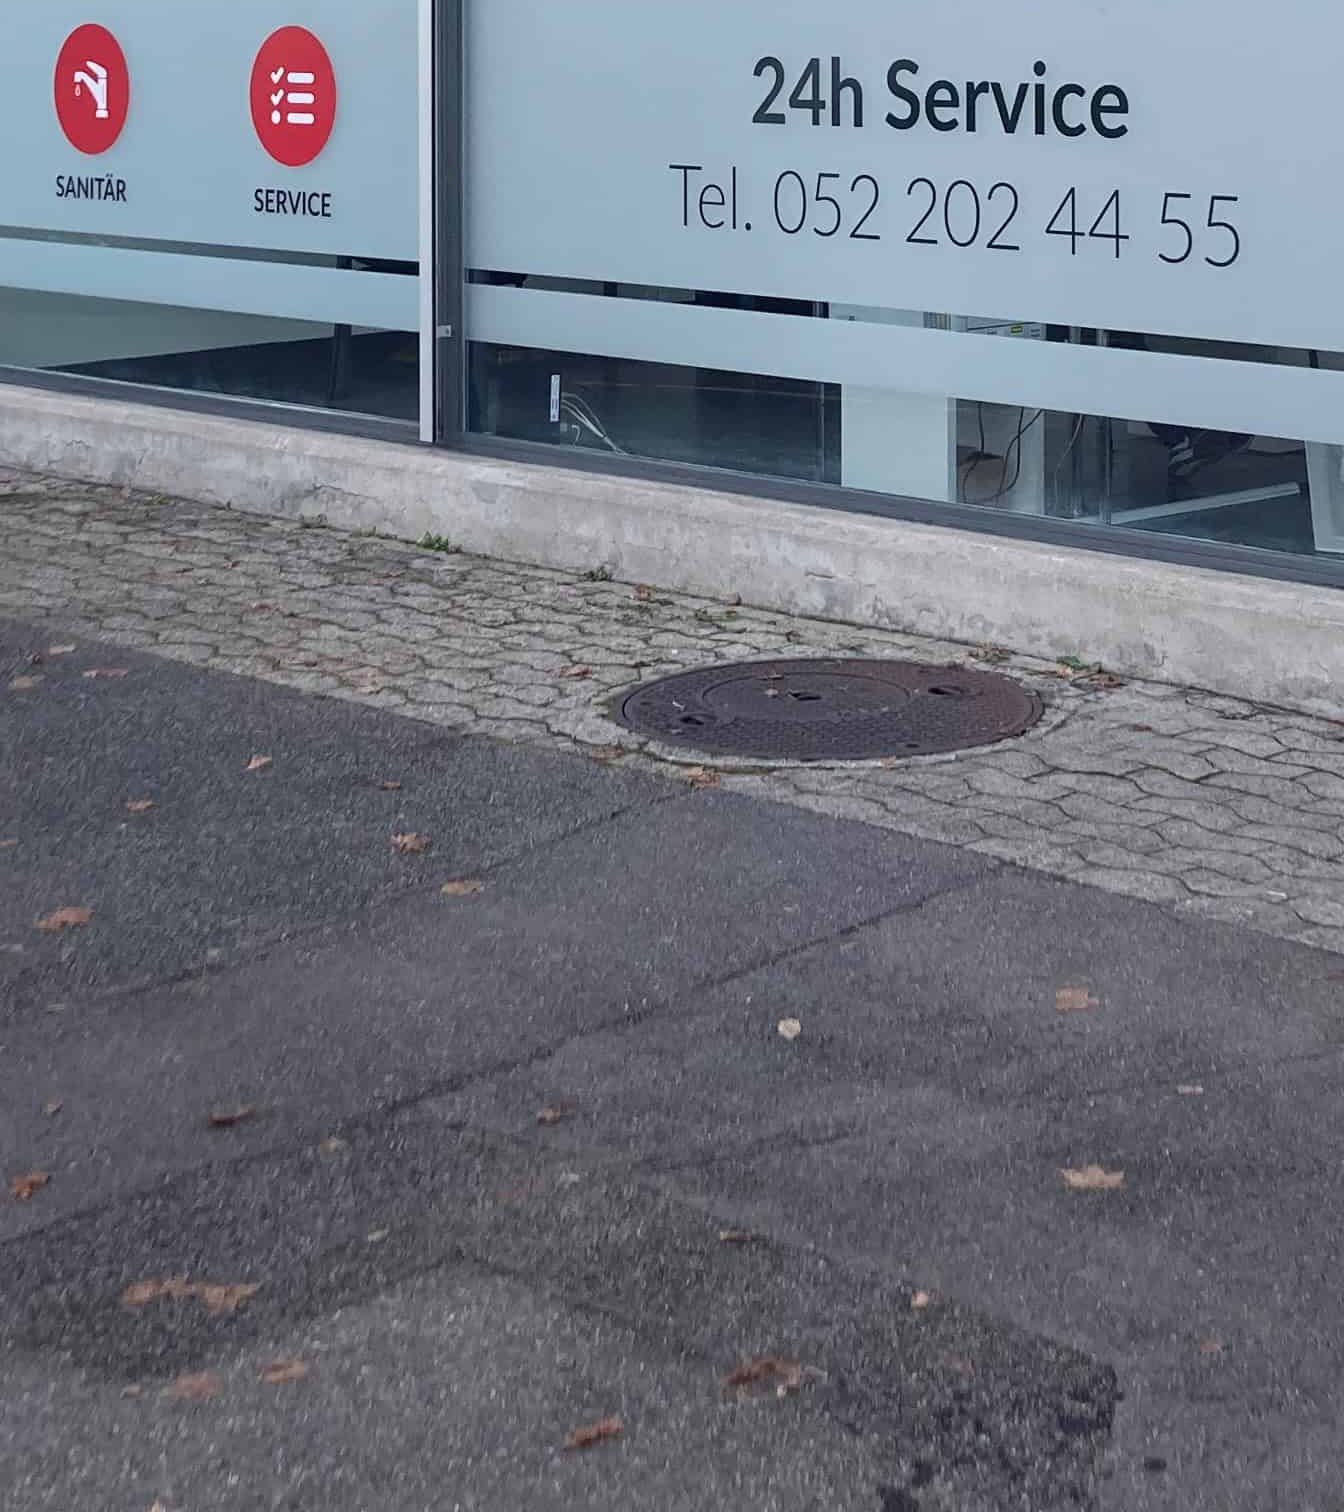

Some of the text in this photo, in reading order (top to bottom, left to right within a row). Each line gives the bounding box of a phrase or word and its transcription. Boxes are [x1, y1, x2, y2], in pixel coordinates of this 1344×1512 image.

[751, 56, 1129, 139] 24h Service
[55, 173, 127, 202] SANITÄR
[254, 188, 332, 218] SERVICE
[668, 164, 1240, 268] Tel. 052 202 44 55
